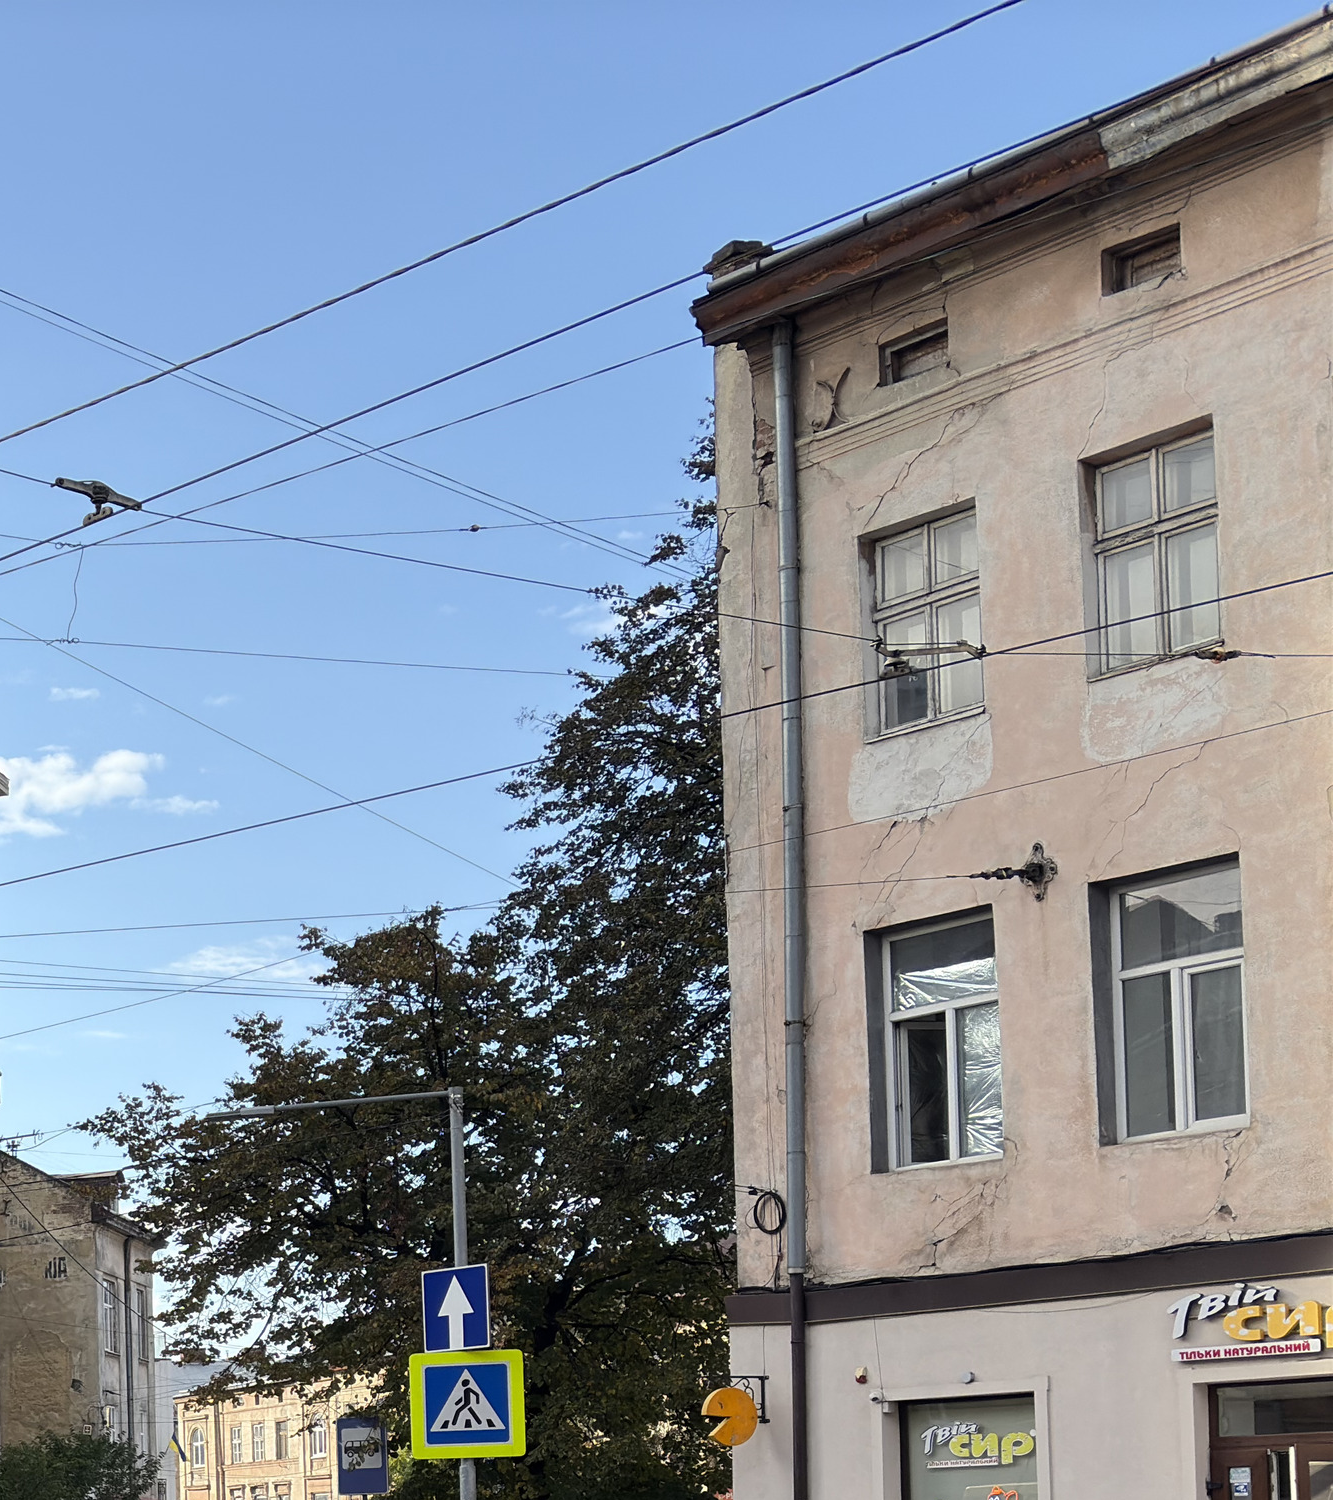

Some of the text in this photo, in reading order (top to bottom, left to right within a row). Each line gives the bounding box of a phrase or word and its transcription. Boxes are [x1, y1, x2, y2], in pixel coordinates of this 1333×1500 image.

[1167, 1282, 1333, 1349] Твій си
[1179, 1341, 1311, 1360] ТІЛЬКИ НАТУРАЛЬНИЙ
[921, 1421, 1035, 1465] Твій сир
